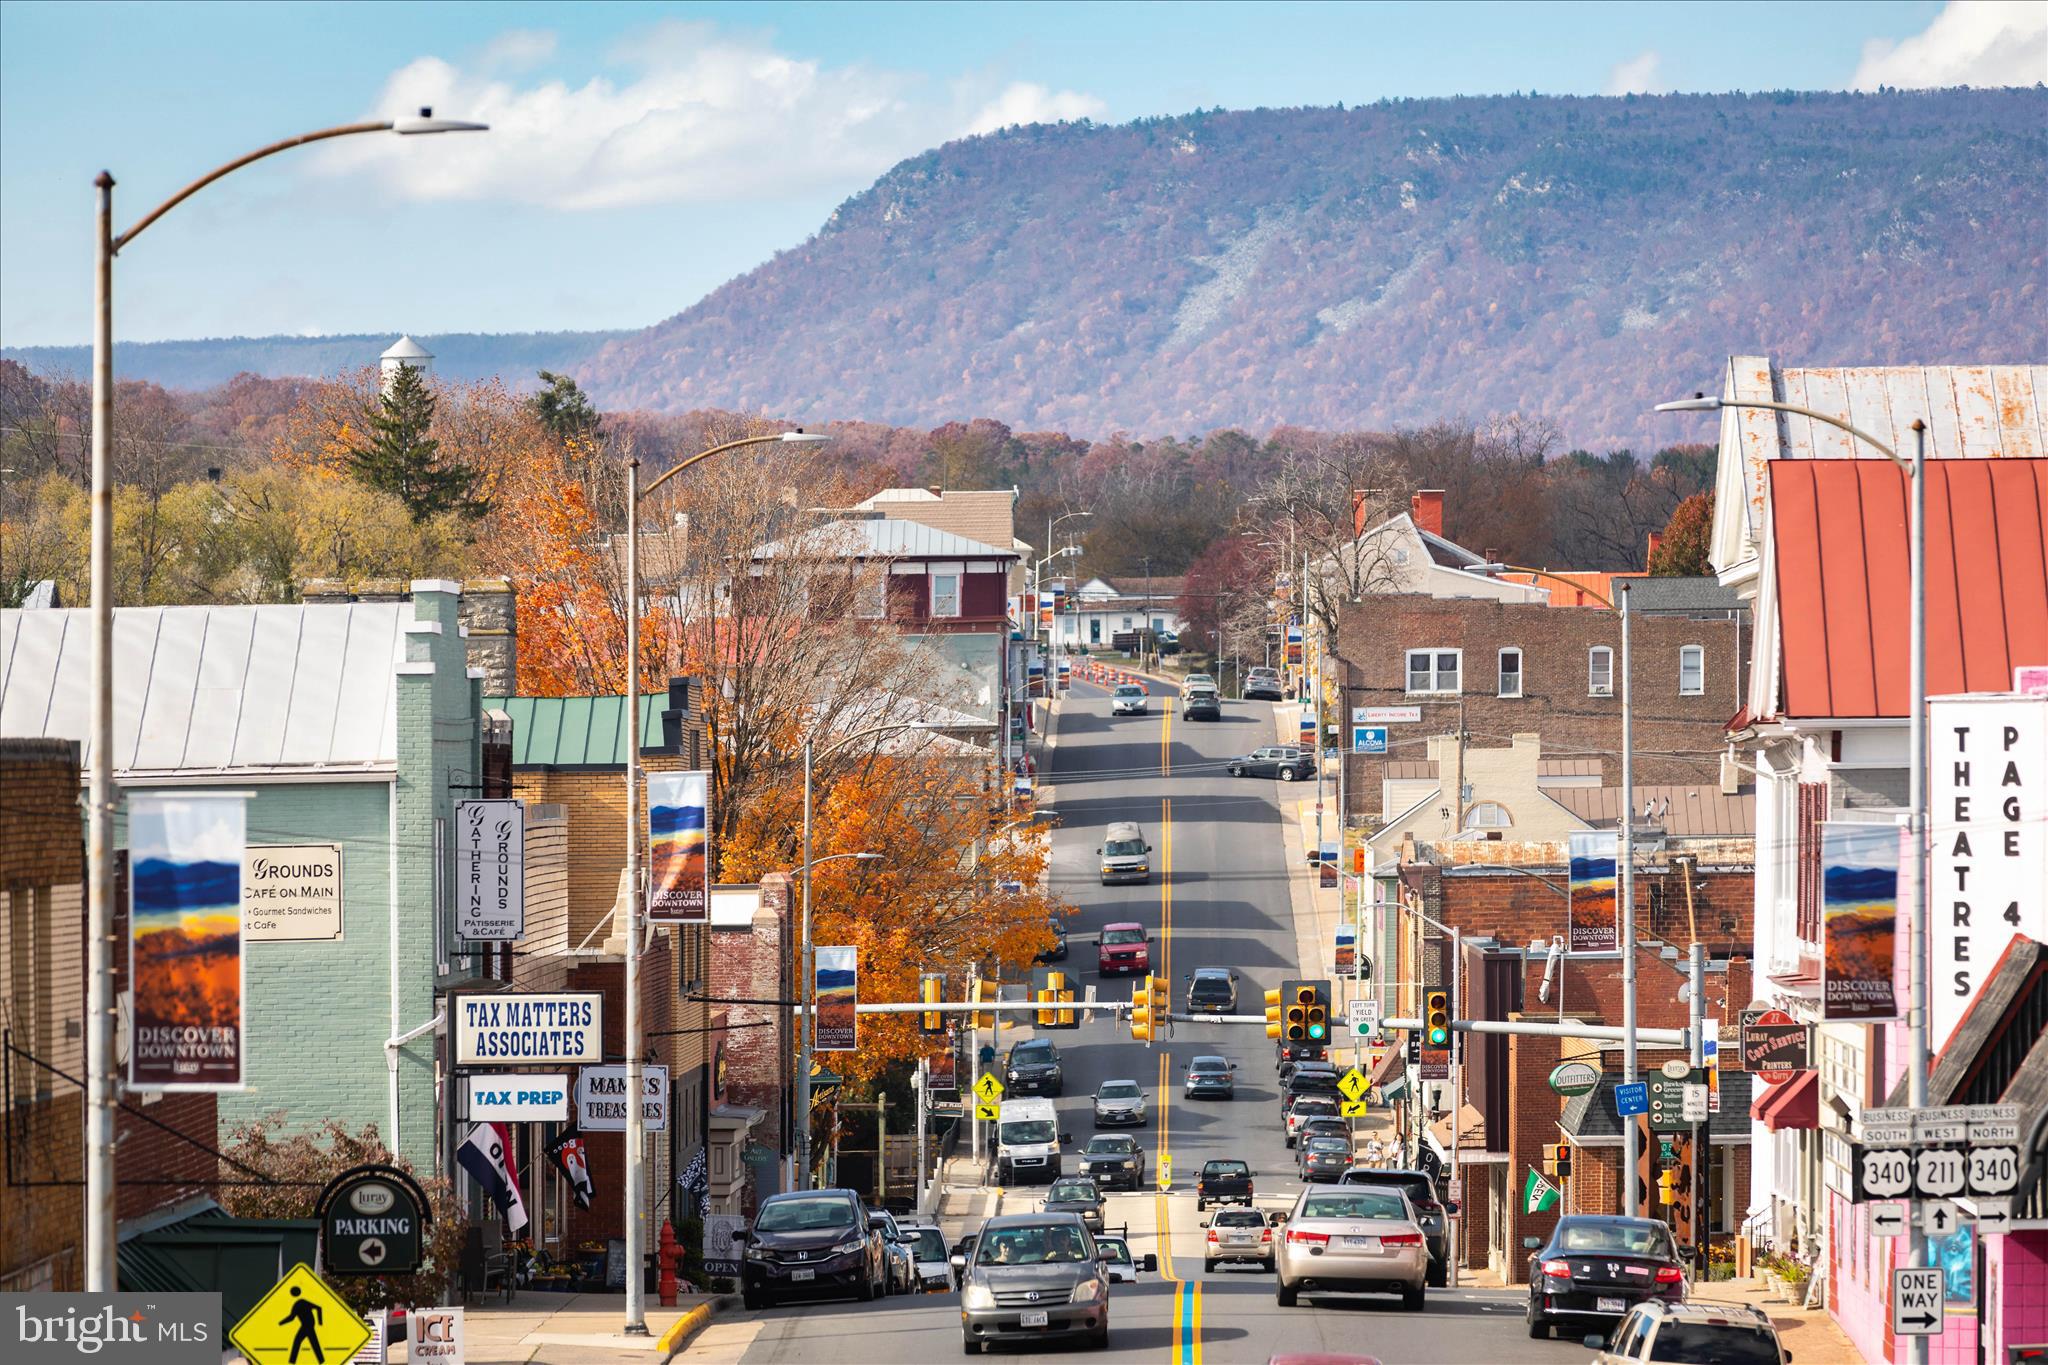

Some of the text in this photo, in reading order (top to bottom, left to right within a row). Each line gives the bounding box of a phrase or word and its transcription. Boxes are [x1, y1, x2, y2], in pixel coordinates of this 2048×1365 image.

[2002, 726, 2021, 927] PAGE 4
[468, 805, 485, 917] GATHERING
[495, 820, 512, 909] GROUNDS
[1952, 727, 1973, 996] THEATRES
[253, 858, 333, 879] GROUNDS
[280, 888, 297, 898] ON
[301, 886, 333, 898] MAIN
[653, 890, 703, 900] DISCOVER
[253, 906, 332, 916] Gourmet Sandwiches
[254, 921, 277, 930] Cafe
[1828, 981, 1890, 992] DISCOVER
[1828, 992, 1892, 1001] DOWNTOWN
[466, 1001, 592, 1027] TAX MATTERS
[1770, 1012, 1780, 1024] 27
[138, 1026, 235, 1043] DISCOVER
[1746, 1031, 1768, 1042] LURAY
[476, 1030, 585, 1057] ASSOCIATES
[1746, 1031, 1806, 1062] COPY SERVICE
[138, 1044, 236, 1058] DOWNTOWN
[1762, 1060, 1792, 1070] PRINTERS
[589, 1077, 661, 1095] MAM'S
[1556, 1074, 1595, 1085] OUTFITTERS
[1620, 1086, 1643, 1095] VISITOR
[1692, 1090, 1700, 1098] 15
[475, 1090, 563, 1105] TAX PREP
[1621, 1095, 1643, 1104] CENTER
[586, 1102, 663, 1119] TREASES
[1863, 1110, 1910, 1123] BUSINESS
[1919, 1108, 1965, 1121] BUSINESS
[1970, 1105, 2017, 1118] BUSINESS
[1866, 1130, 1908, 1141] SOUTH
[1924, 1128, 1958, 1138] WEST
[1973, 1128, 2015, 1138] NORTH
[1869, 1162, 1905, 1185] 340
[1928, 1161, 1955, 1184] 211
[1976, 1158, 2011, 1181] 340
[336, 1218, 410, 1236] PARKING
[704, 1262, 739, 1273] OPEN
[1902, 1274, 1937, 1290] ONE
[1902, 1293, 1938, 1308] WAY
[415, 1314, 454, 1343] ICE
[415, 1344, 456, 1357] CREAM
